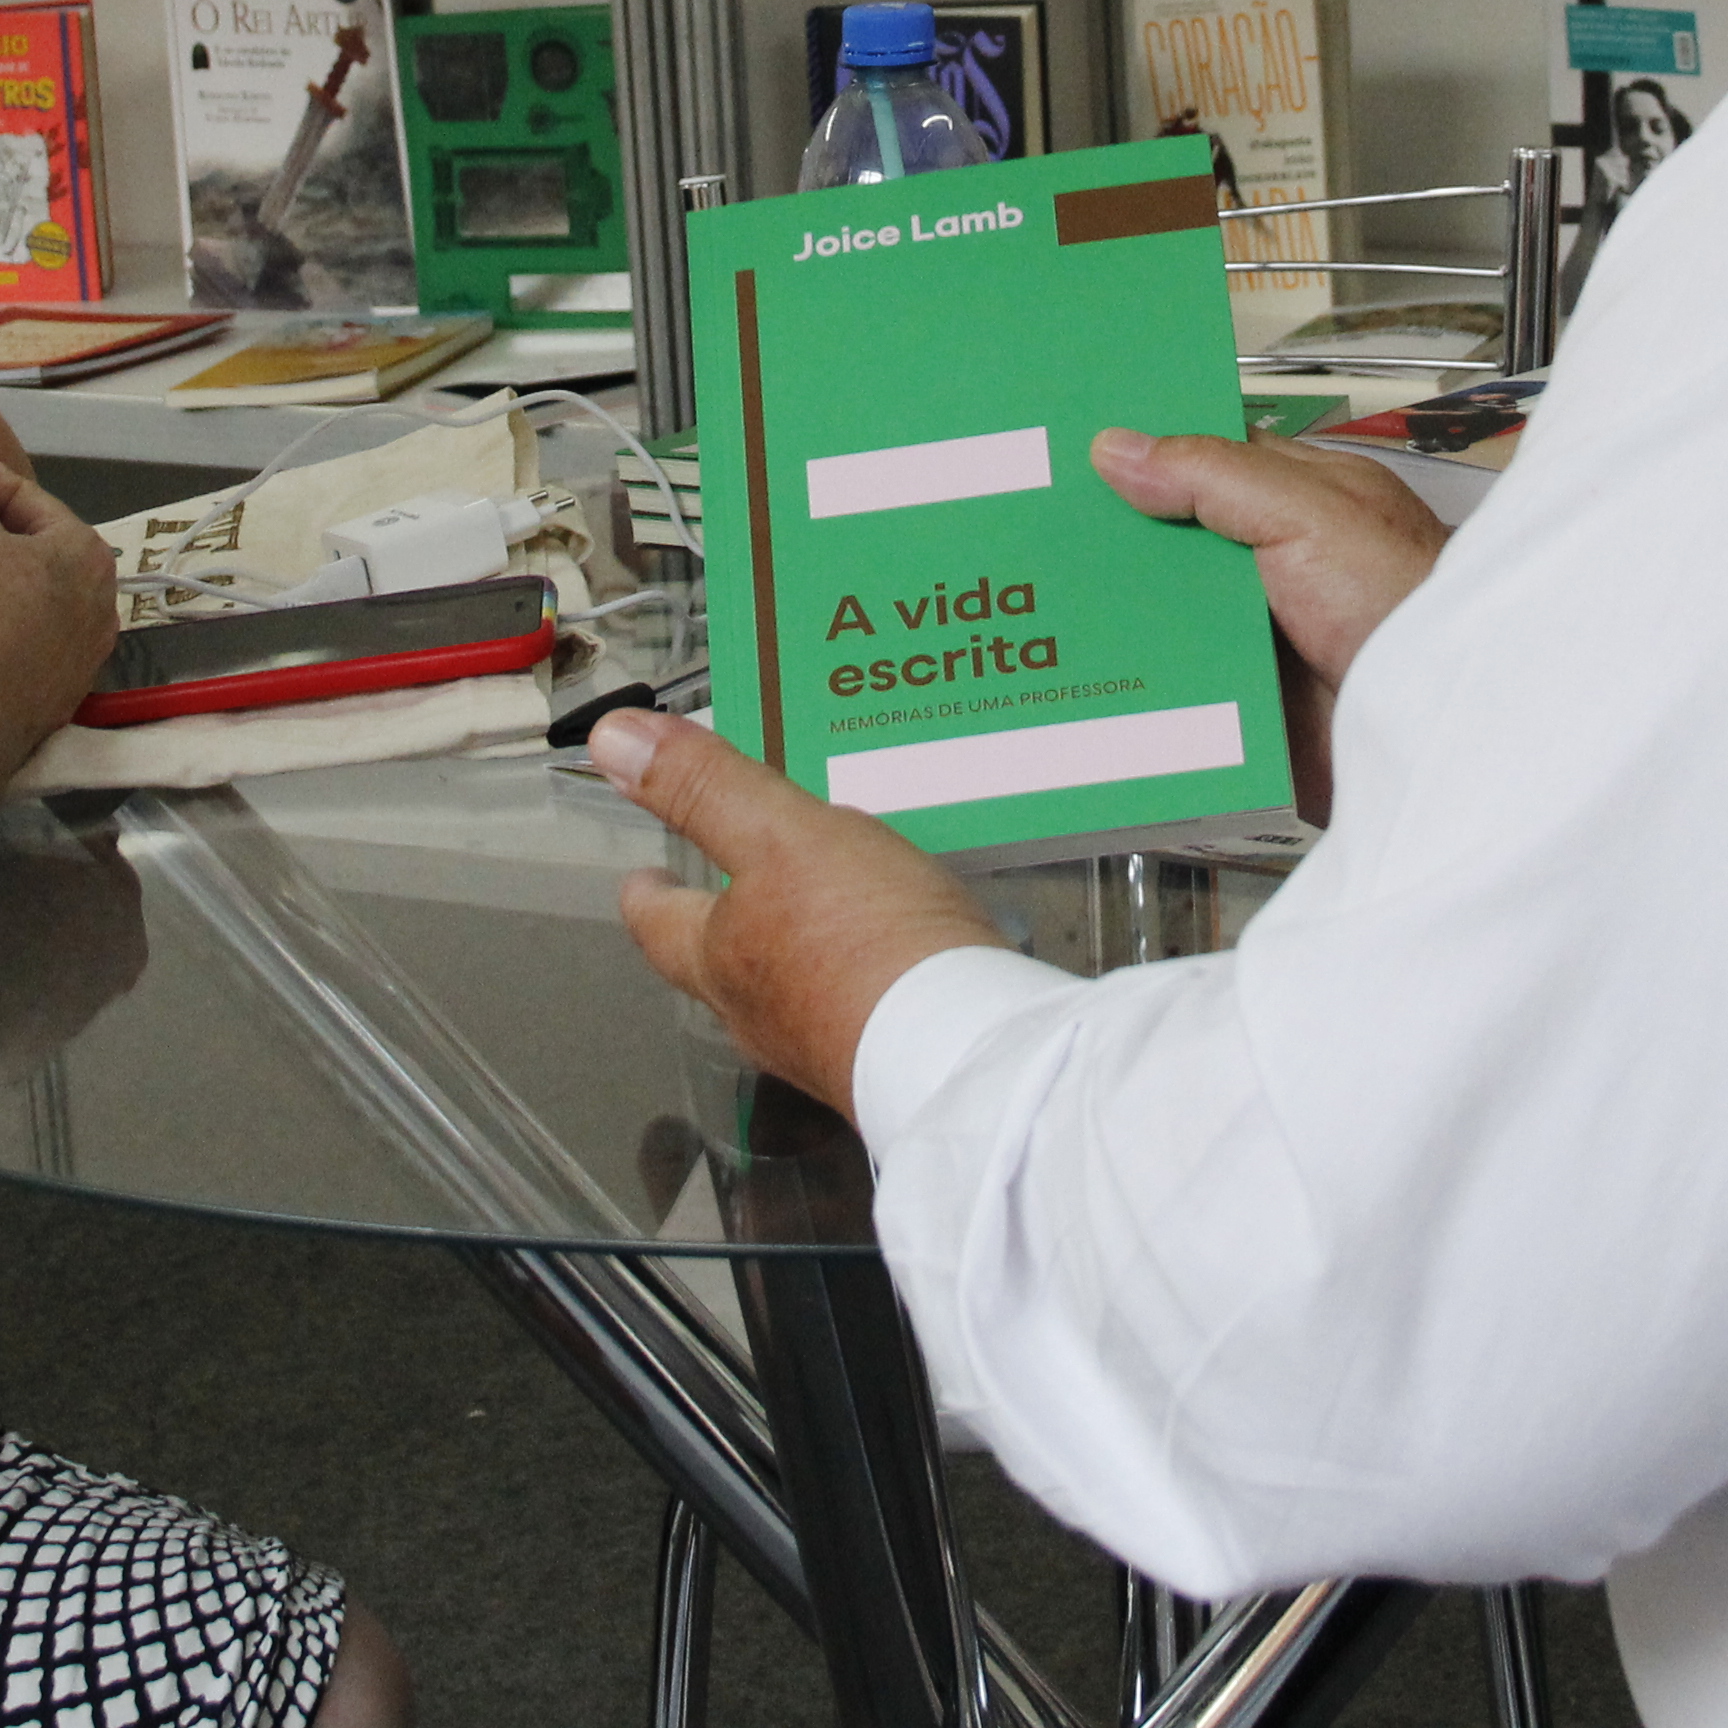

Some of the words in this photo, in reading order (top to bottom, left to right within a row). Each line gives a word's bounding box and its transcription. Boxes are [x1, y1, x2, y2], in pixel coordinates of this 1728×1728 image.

[191, 0, 220, 35] O
[793, 221, 900, 262] Joice
[910, 202, 1024, 243] Lamb
[825, 594, 877, 641] A
[893, 576, 1036, 631] vida
[827, 634, 1059, 697] escrita
[829, 704, 934, 734] MEMÓRIAS
[938, 701, 964, 719] DE
[968, 694, 1015, 713] UMA
[1020, 677, 1146, 706] PROFESSORA
